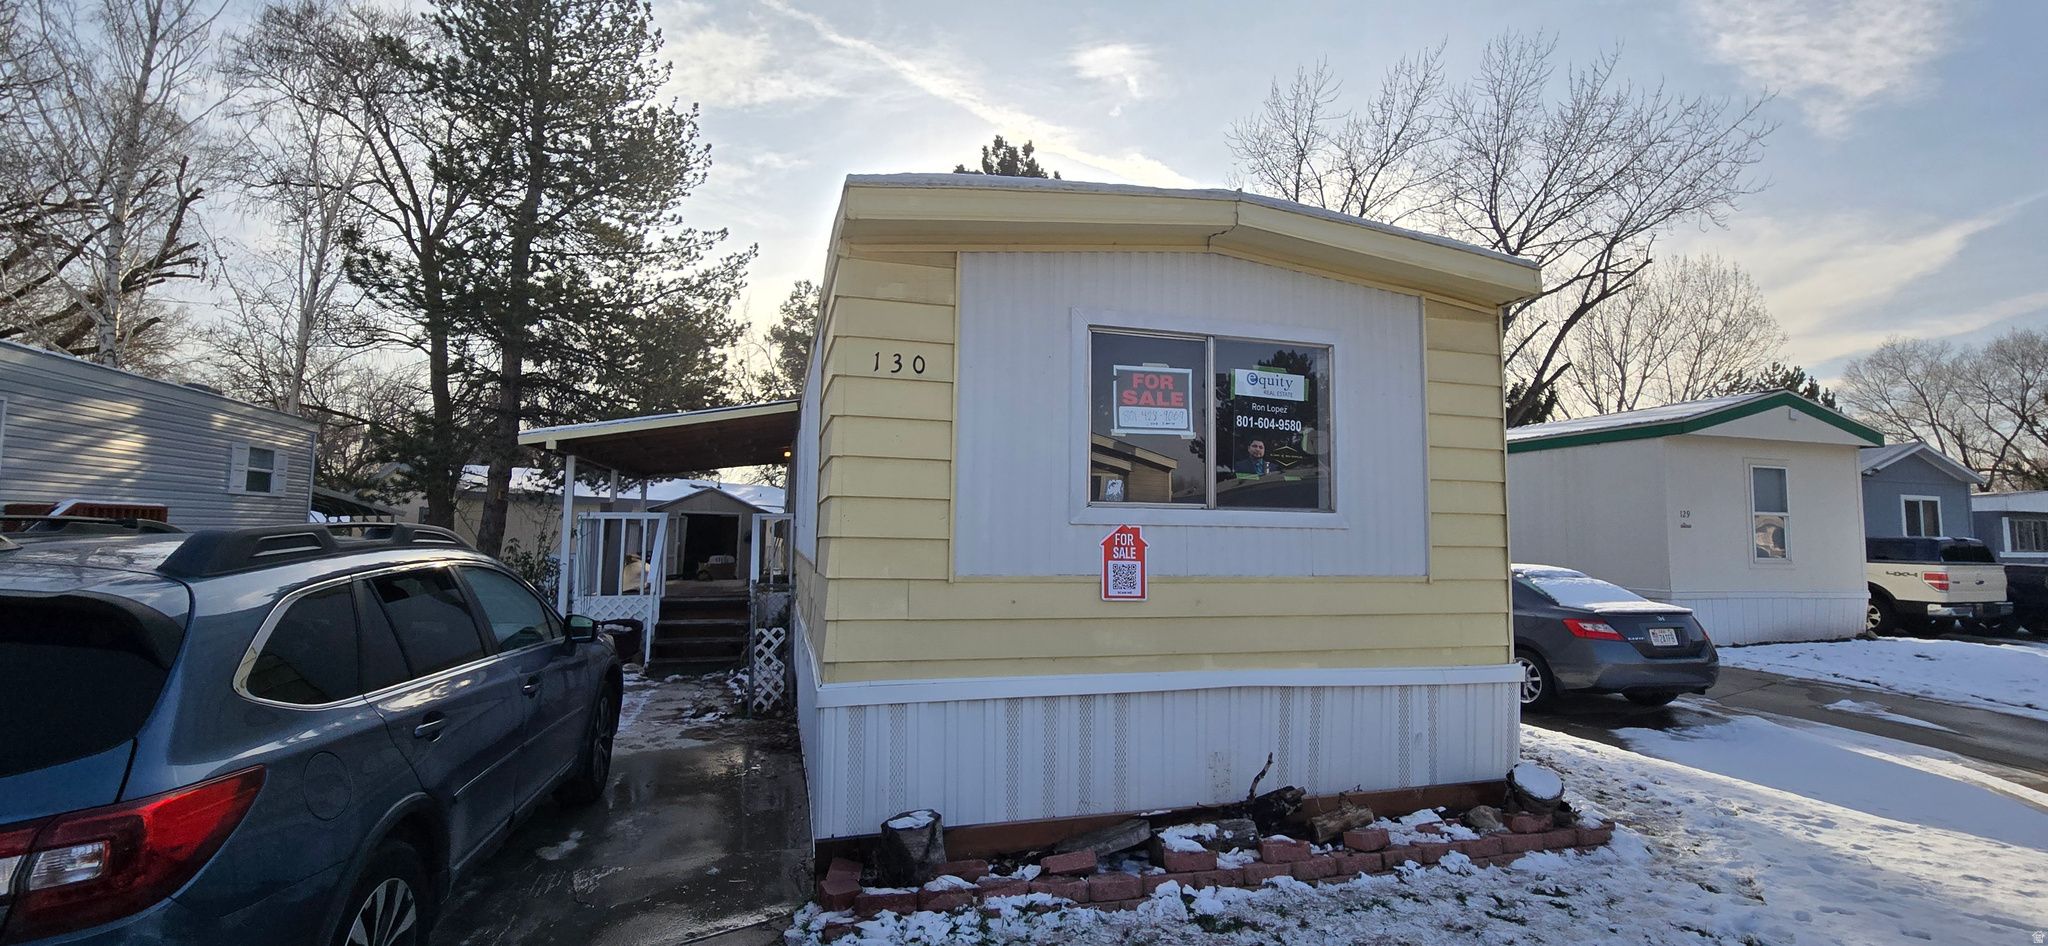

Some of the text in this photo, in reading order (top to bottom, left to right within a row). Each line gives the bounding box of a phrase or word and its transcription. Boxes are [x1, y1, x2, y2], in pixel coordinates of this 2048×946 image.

[873, 351, 926, 375] 130
[1132, 373, 1175, 391] FOR
[1246, 372, 1294, 392] equity
[1122, 390, 1184, 408] SALE
[1251, 402, 1288, 415] Ron Lopez
[1236, 415, 1302, 432] 801-604-9580
[1680, 510, 1691, 518] 129
[1114, 533, 1134, 546] FOR
[1112, 546, 1136, 560] SALE
